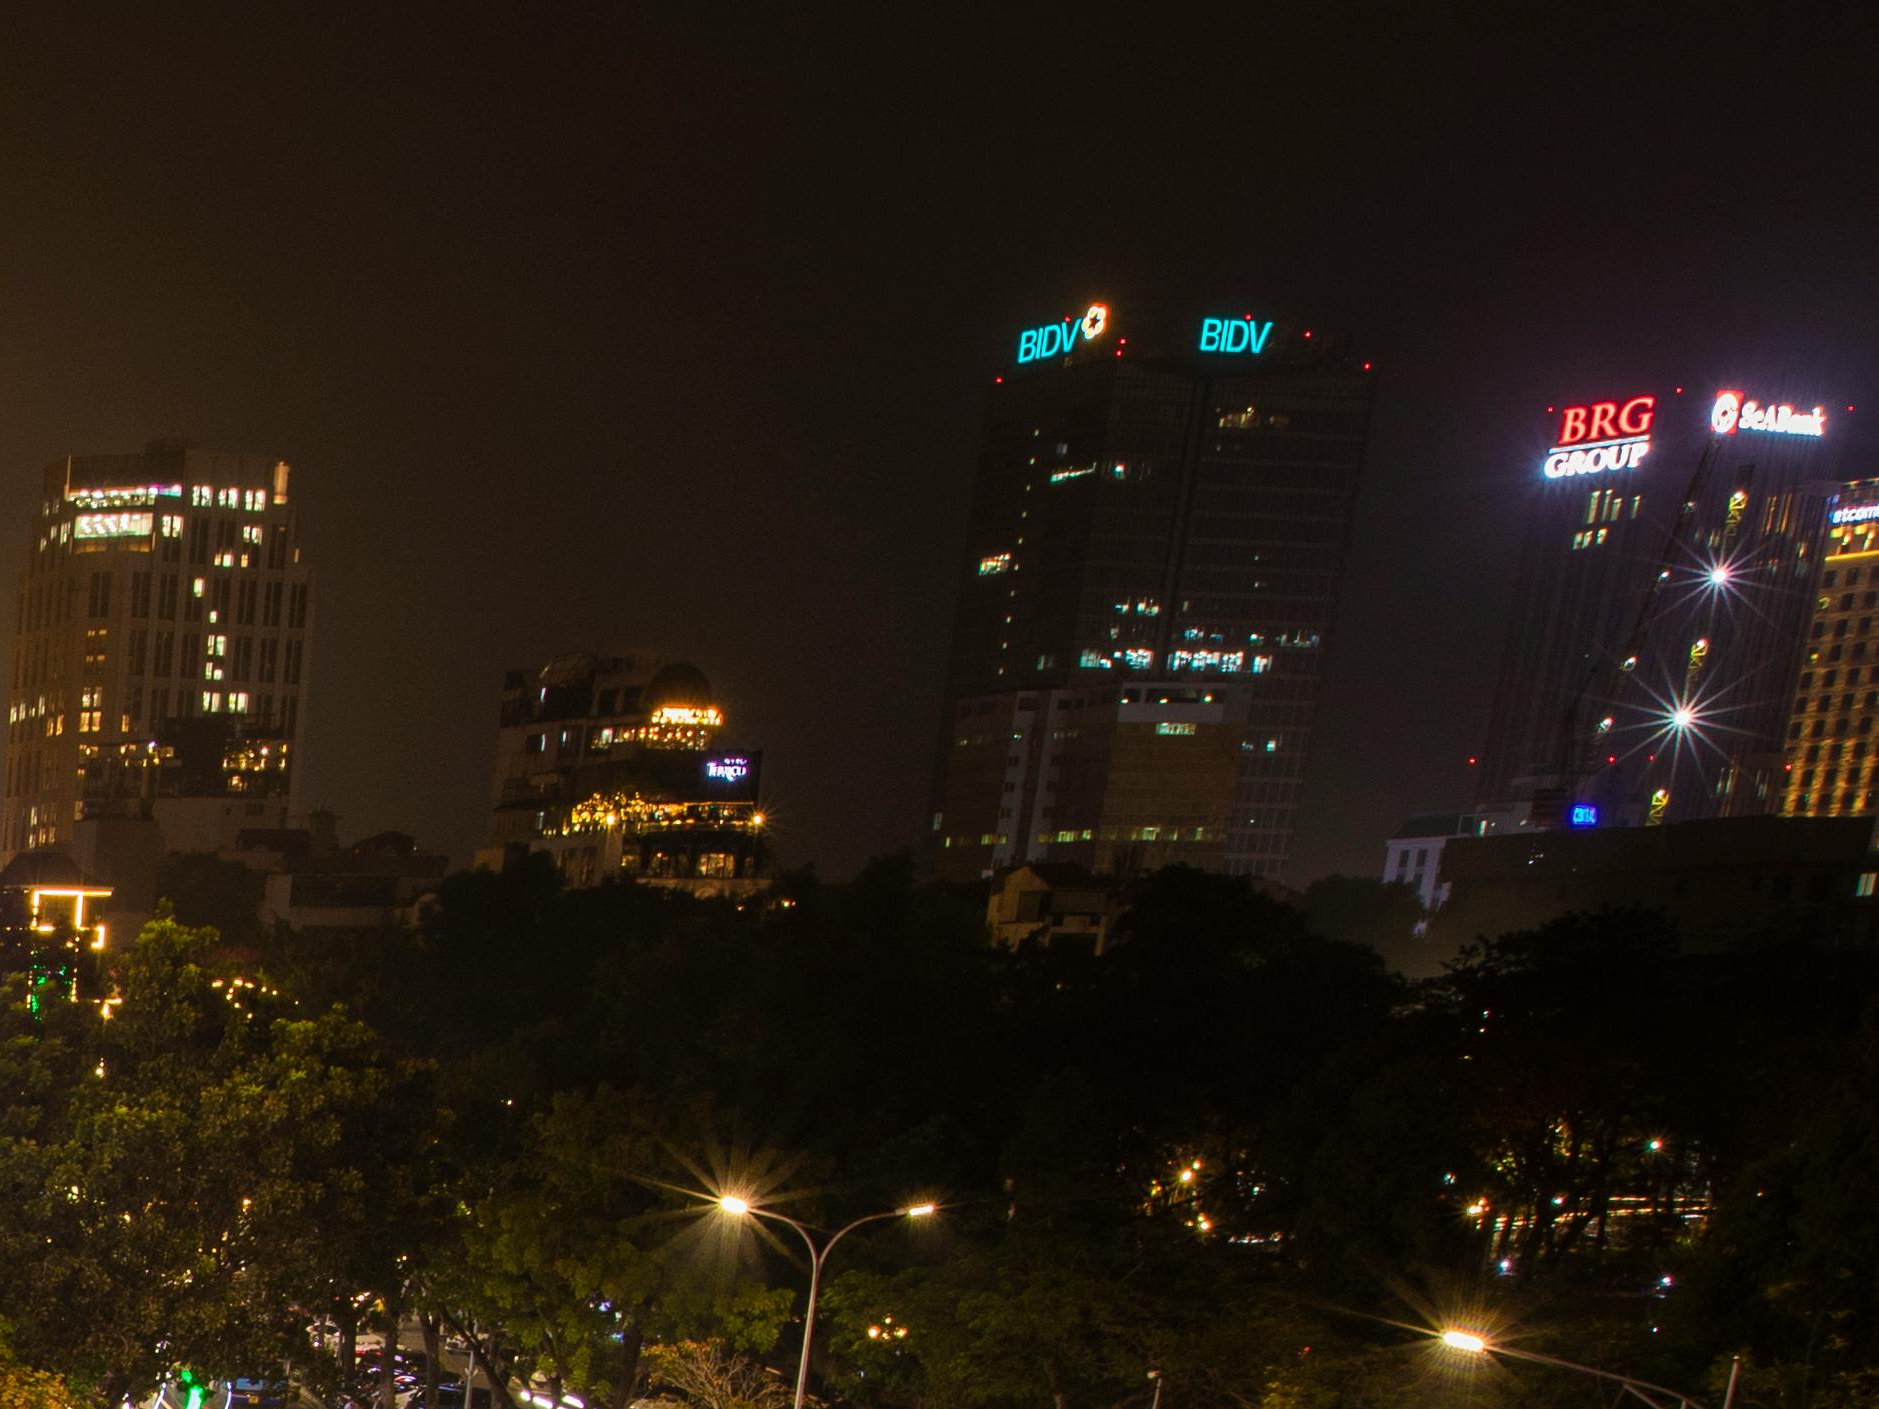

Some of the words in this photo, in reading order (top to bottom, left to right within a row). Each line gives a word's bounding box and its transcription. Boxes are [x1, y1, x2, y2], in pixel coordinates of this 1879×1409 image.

[1018, 318, 1082, 363] BIDV
[1199, 318, 1273, 353] BIDV
[1558, 397, 1655, 445] BRG
[1543, 442, 1650, 479] GROUP
